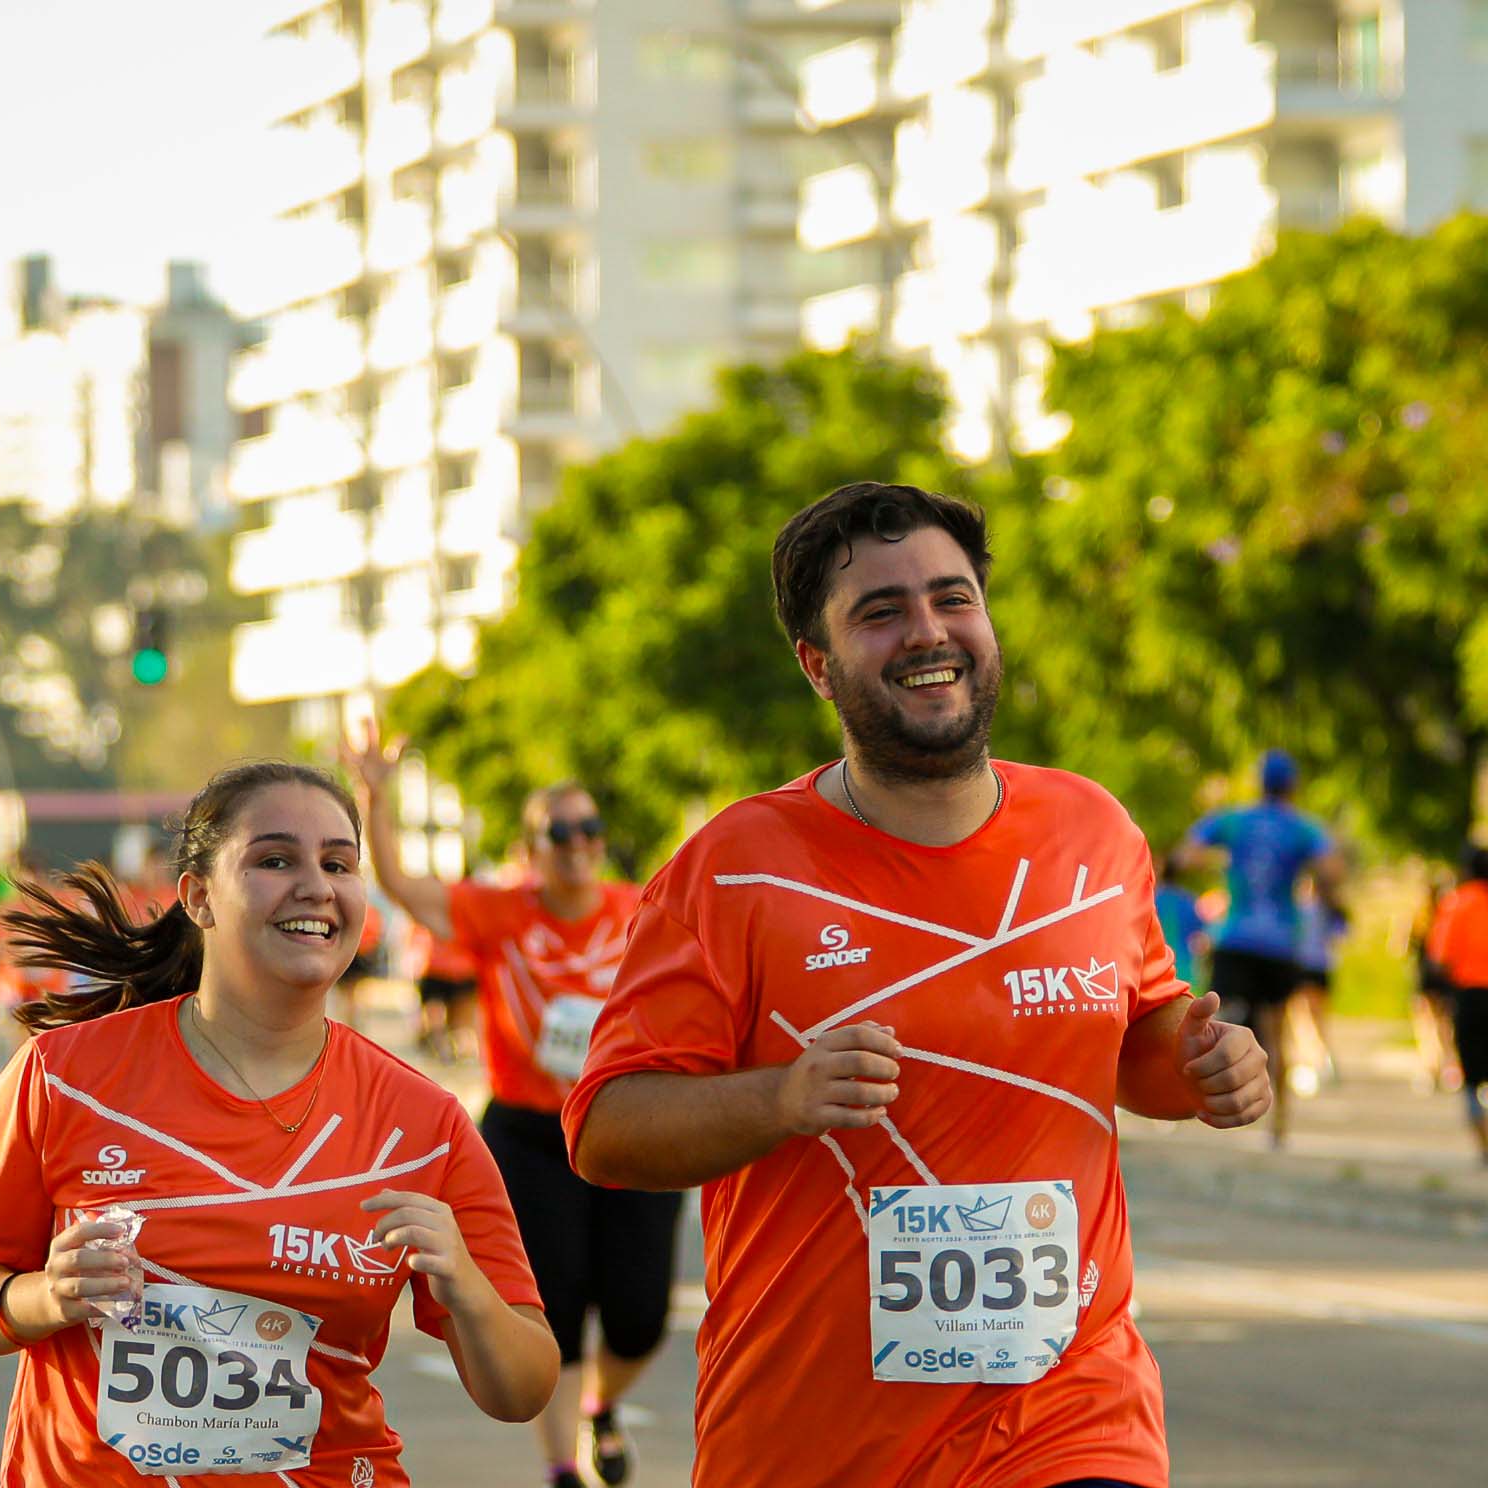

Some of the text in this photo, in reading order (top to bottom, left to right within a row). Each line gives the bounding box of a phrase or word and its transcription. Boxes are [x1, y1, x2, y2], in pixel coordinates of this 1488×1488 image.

[1003, 967, 1075, 1005] 15K
[1013, 1004, 1076, 1017] PUERTO
[892, 1204, 952, 1234] 15K
[1031, 1203, 1050, 1219] 4K
[268, 1223, 342, 1268] 15K
[270, 1260, 394, 1287] PUERTO NORTE
[879, 1243, 1069, 1313] 5033
[143, 1300, 188, 1332] 5K
[261, 1318, 286, 1333] 4K
[935, 1317, 1025, 1333] Villani Martin
[107, 1340, 312, 1411] 5034
[136, 1412, 198, 1429] Chambon
[244, 1417, 279, 1429] Paula
